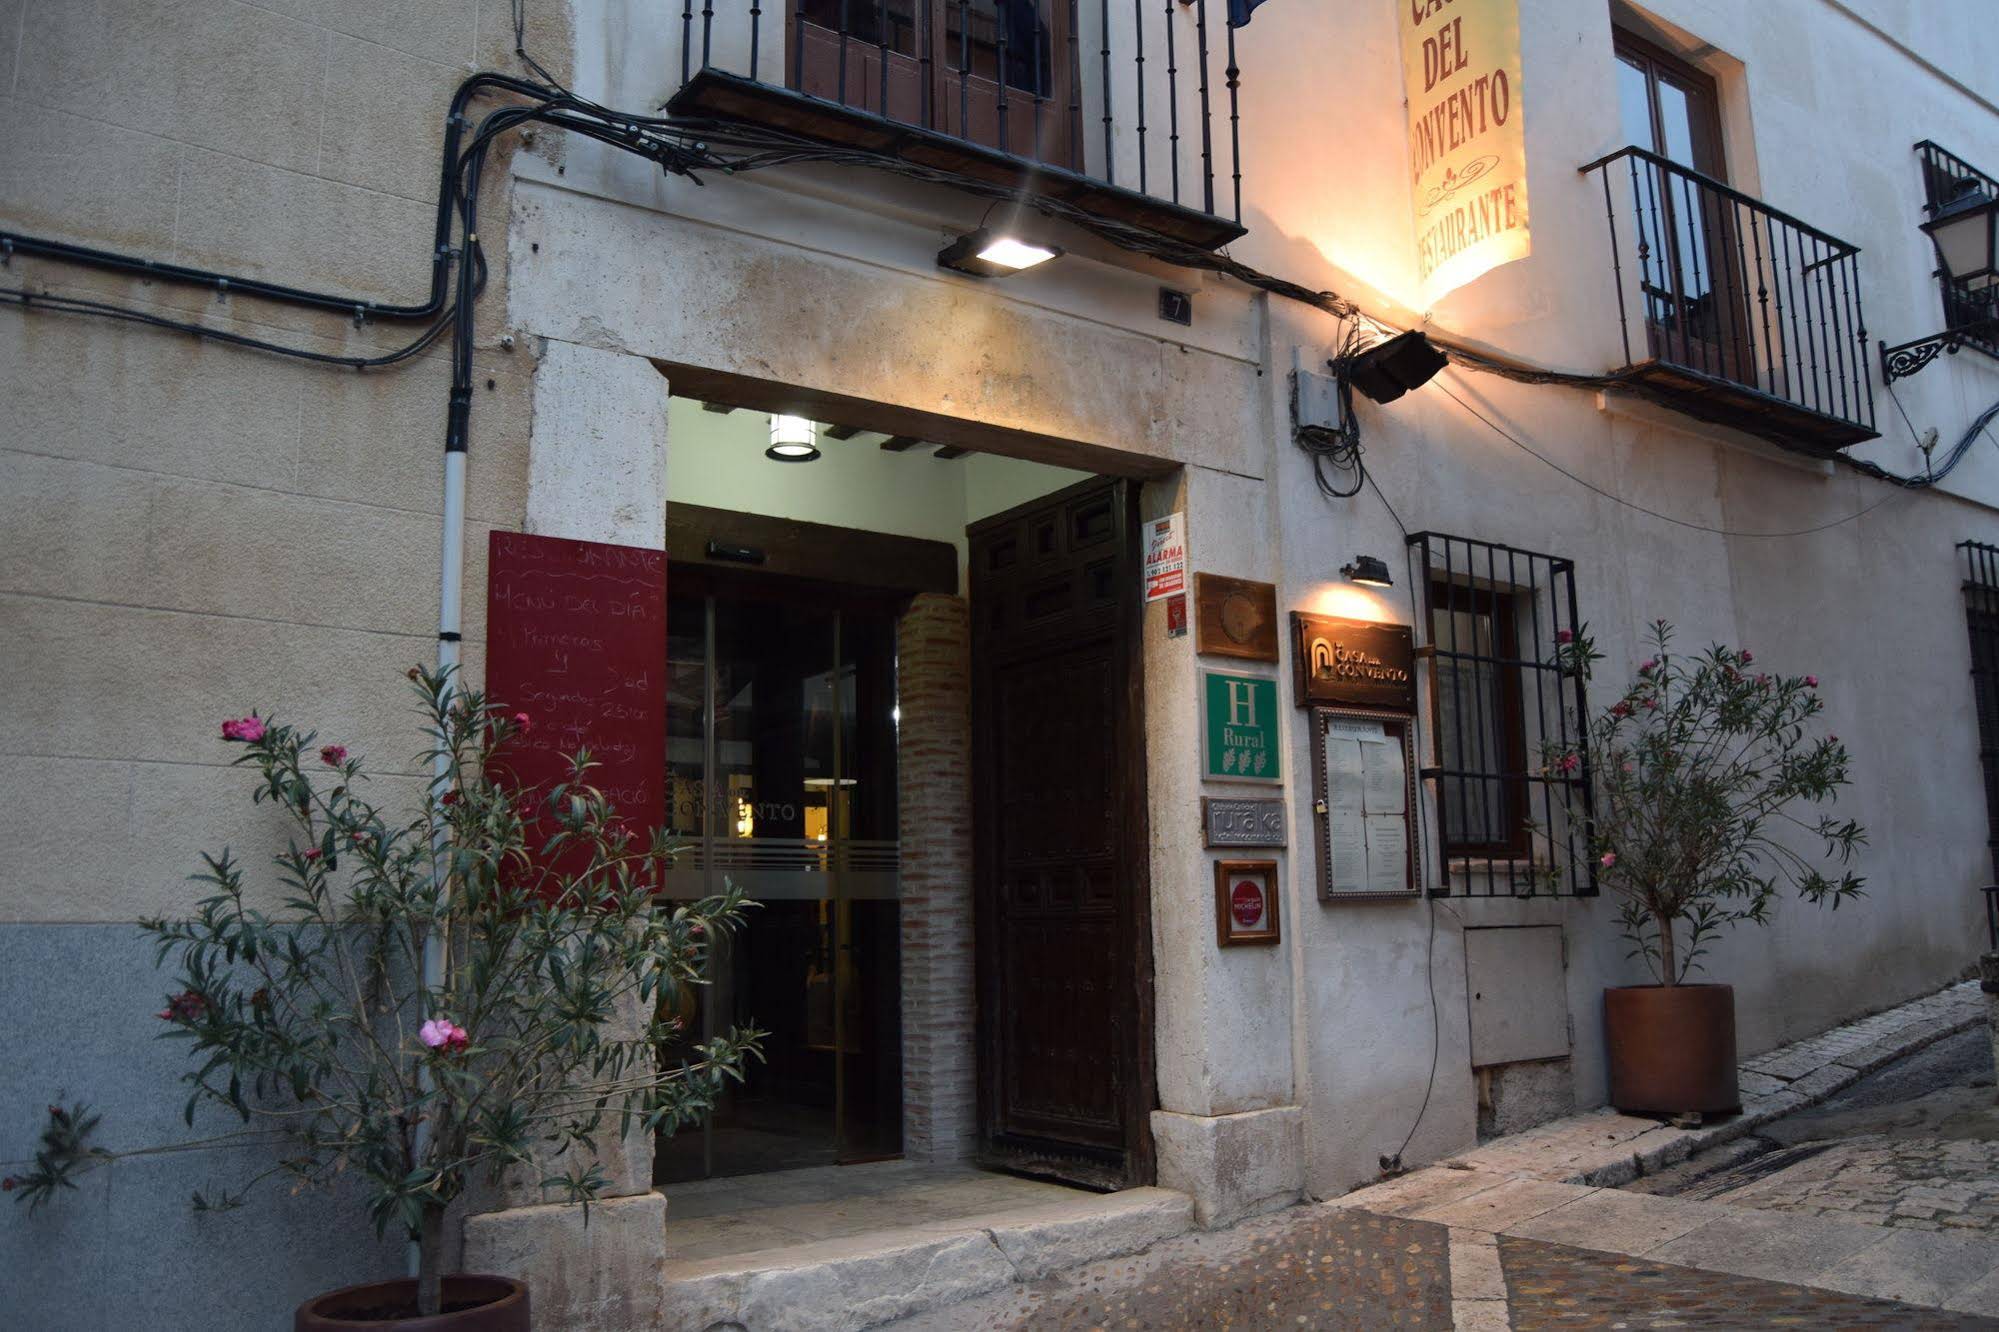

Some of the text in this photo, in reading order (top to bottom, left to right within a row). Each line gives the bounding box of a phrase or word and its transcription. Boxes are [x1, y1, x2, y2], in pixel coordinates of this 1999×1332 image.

[1422, 16, 1468, 94] DEL
[1173, 295, 1182, 318] 7
[1146, 545, 1184, 565] ALARMA
[1336, 649, 1367, 664] CASA
[1336, 663, 1408, 682] CONVENTO
[1224, 680, 1262, 727] H
[1223, 727, 1265, 748] Rural
